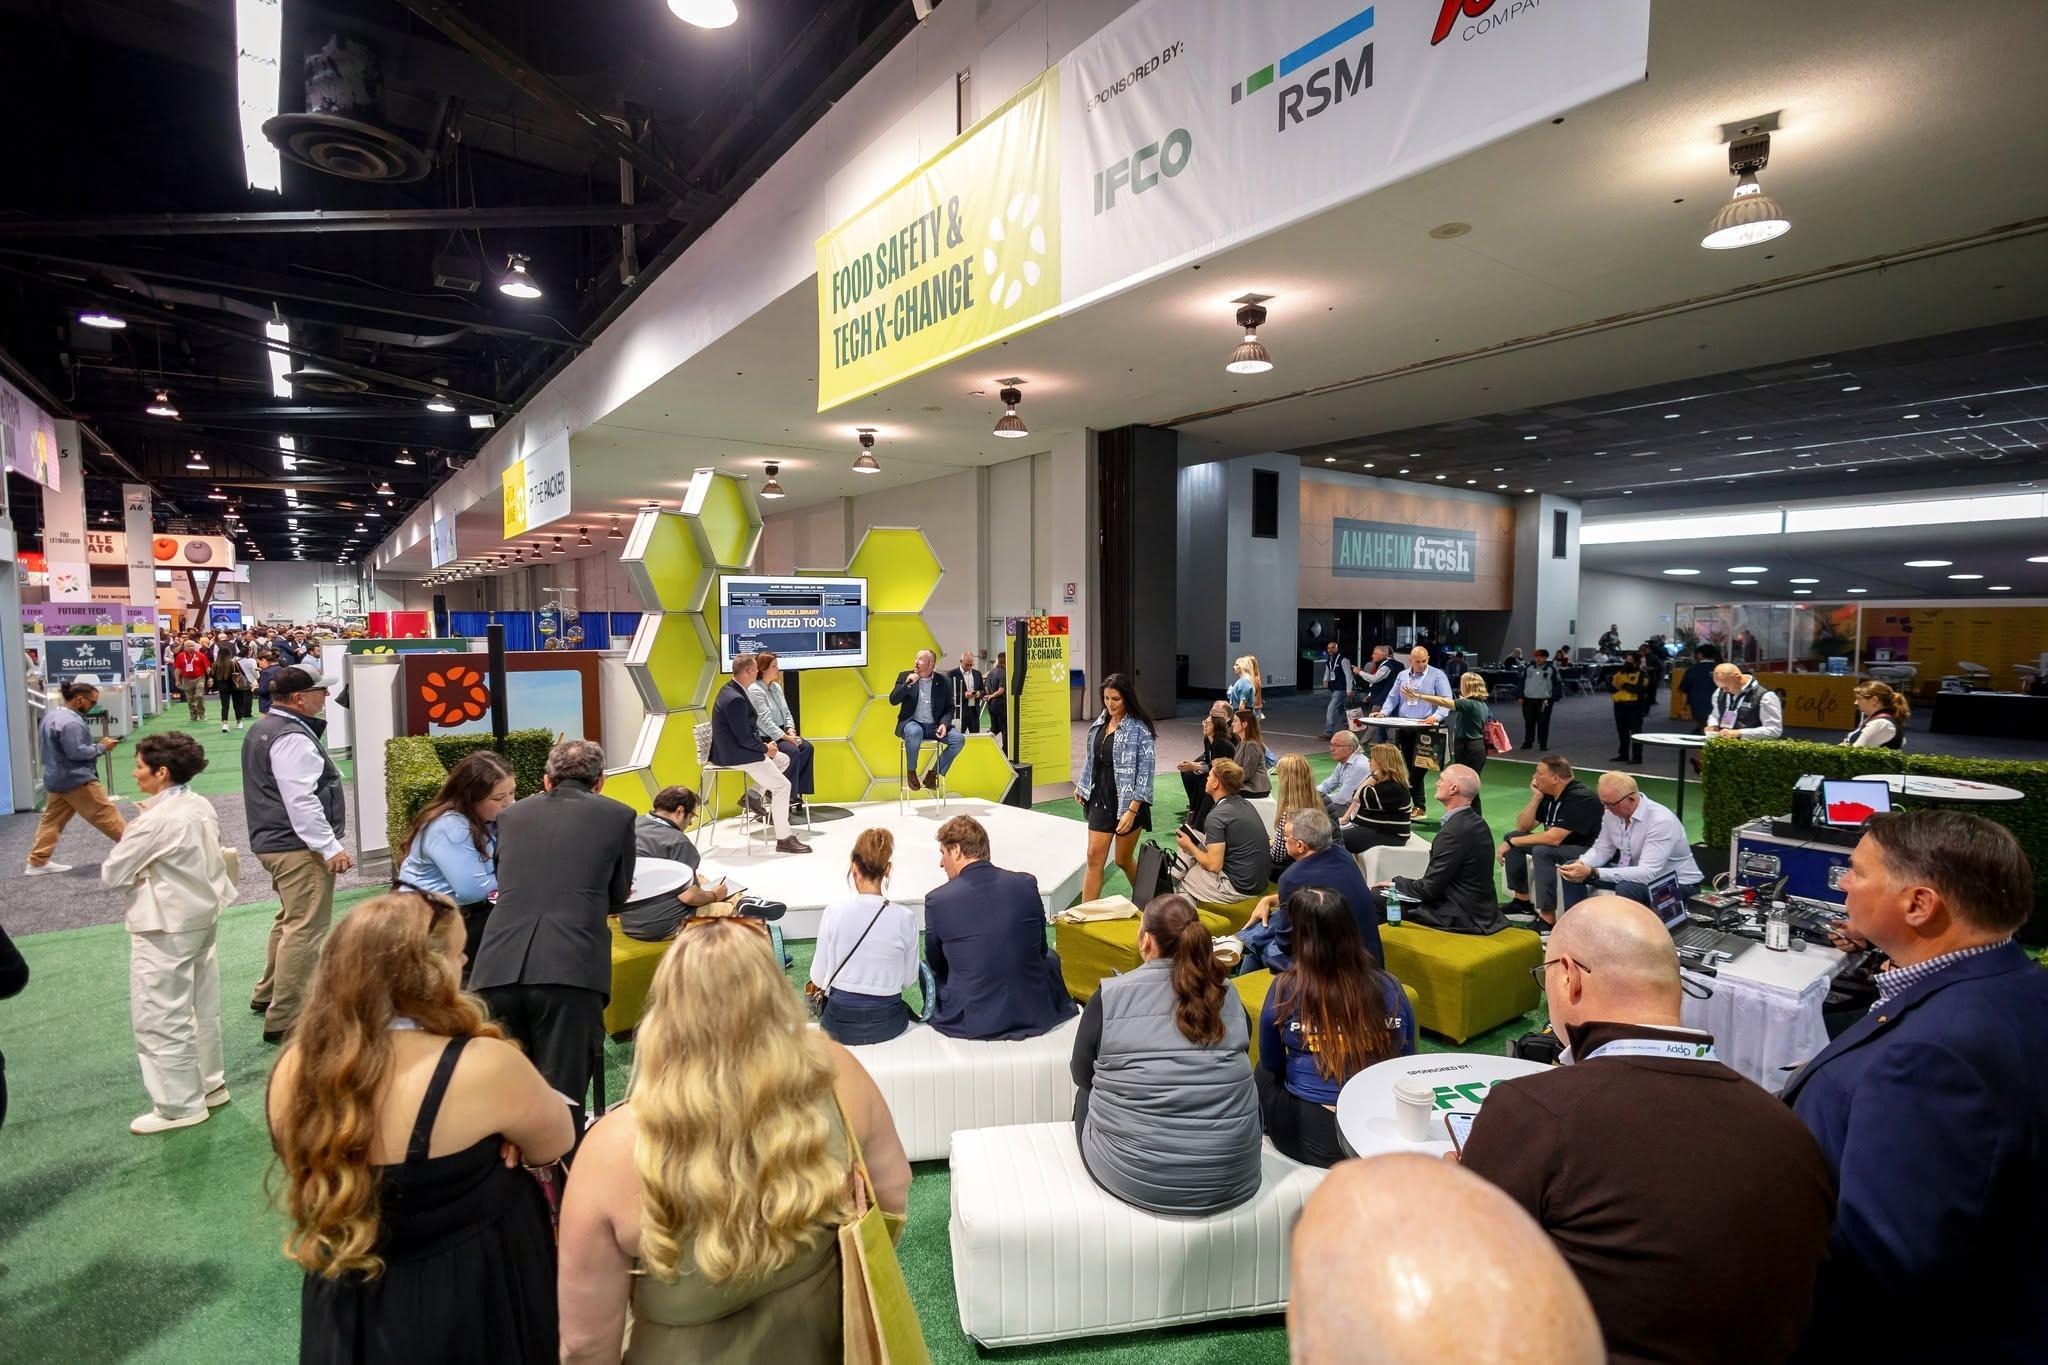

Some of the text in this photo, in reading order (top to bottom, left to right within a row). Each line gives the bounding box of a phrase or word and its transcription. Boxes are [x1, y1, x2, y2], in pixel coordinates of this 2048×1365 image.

[1463, 0, 1541, 41] COMPA
[1086, 41, 1184, 113] SPONSORED BY:
[1278, 41, 1374, 133] RSM
[1093, 128, 1193, 216] IFCO
[832, 194, 965, 314] FOOD SAFETY &
[833, 255, 975, 369] TECH X-CHANGE
[60, 449, 69, 459] 5
[544, 471, 566, 499] PACKER
[87, 535, 112, 544] TLE
[88, 544, 114, 553] ATO
[1340, 530, 1470, 572] ANAHEIM fresh
[58, 607, 107, 616] FUTURE TECH
[748, 617, 836, 629] DIGITIZED TOOLS
[1033, 637, 1055, 649] SAFETY
[1056, 637, 1061, 648] &
[62, 658, 111, 667] Starfish
[1031, 648, 1063, 660] X-CHANGE
[1406, 1063, 1472, 1076] SPONSORED BY:
[1430, 1079, 1506, 1111] FC
